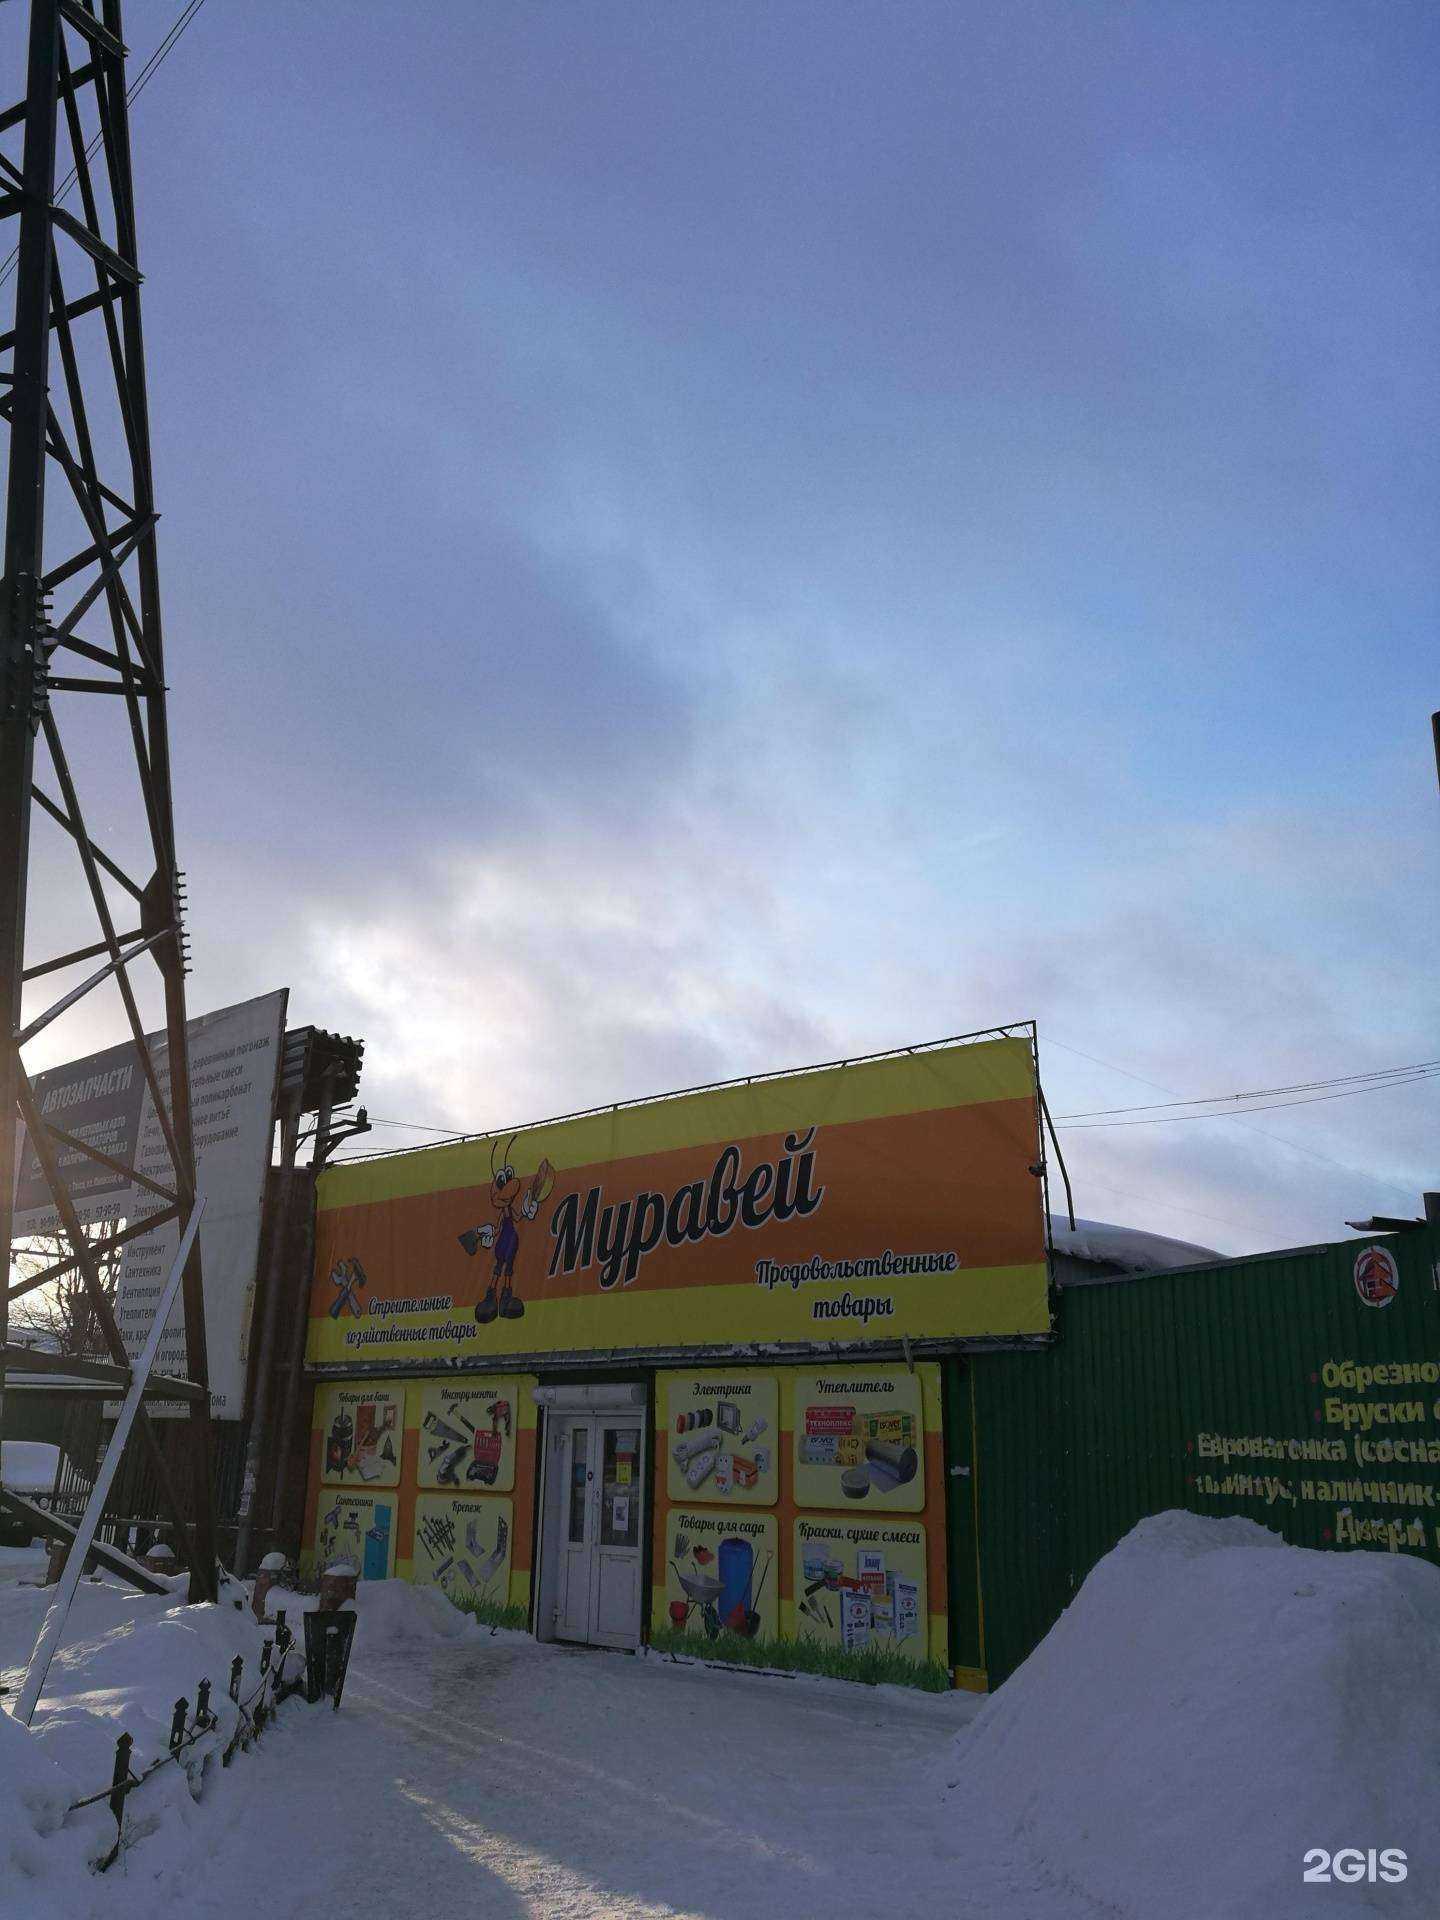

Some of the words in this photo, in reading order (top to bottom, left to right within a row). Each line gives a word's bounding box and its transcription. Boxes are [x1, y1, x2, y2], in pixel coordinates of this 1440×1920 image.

[41, 1065, 133, 1115] АВТОЗАПЧАСТИ
[548, 1126, 824, 1289] Муравей
[127, 1245, 166, 1260] Инструмент
[124, 1265, 162, 1279] Сантехника
[755, 1249, 958, 1290] Продовольственные
[121, 1286, 161, 1299] Вентиляция
[368, 1295, 452, 1318] Строительные
[812, 1291, 894, 1323] товары
[429, 1320, 478, 1343] товары
[815, 1380, 896, 1394] Утеплитель
[1322, 1360, 1440, 1393] Обрезно
[441, 1388, 498, 1402] Инструменты
[693, 1382, 752, 1398] Электрика
[1324, 1397, 1425, 1430] Бруски
[1198, 1432, 1347, 1464] Евровагонка
[335, 1494, 373, 1506] Сантехника
[1301, 1478, 1440, 1507] наличник
[678, 1515, 716, 1533] Товары
[716, 1520, 738, 1534] для
[739, 1522, 765, 1535] сада
[799, 1522, 845, 1541] Краски,
[846, 1528, 881, 1543] сухие
[882, 1530, 920, 1543] смеси
